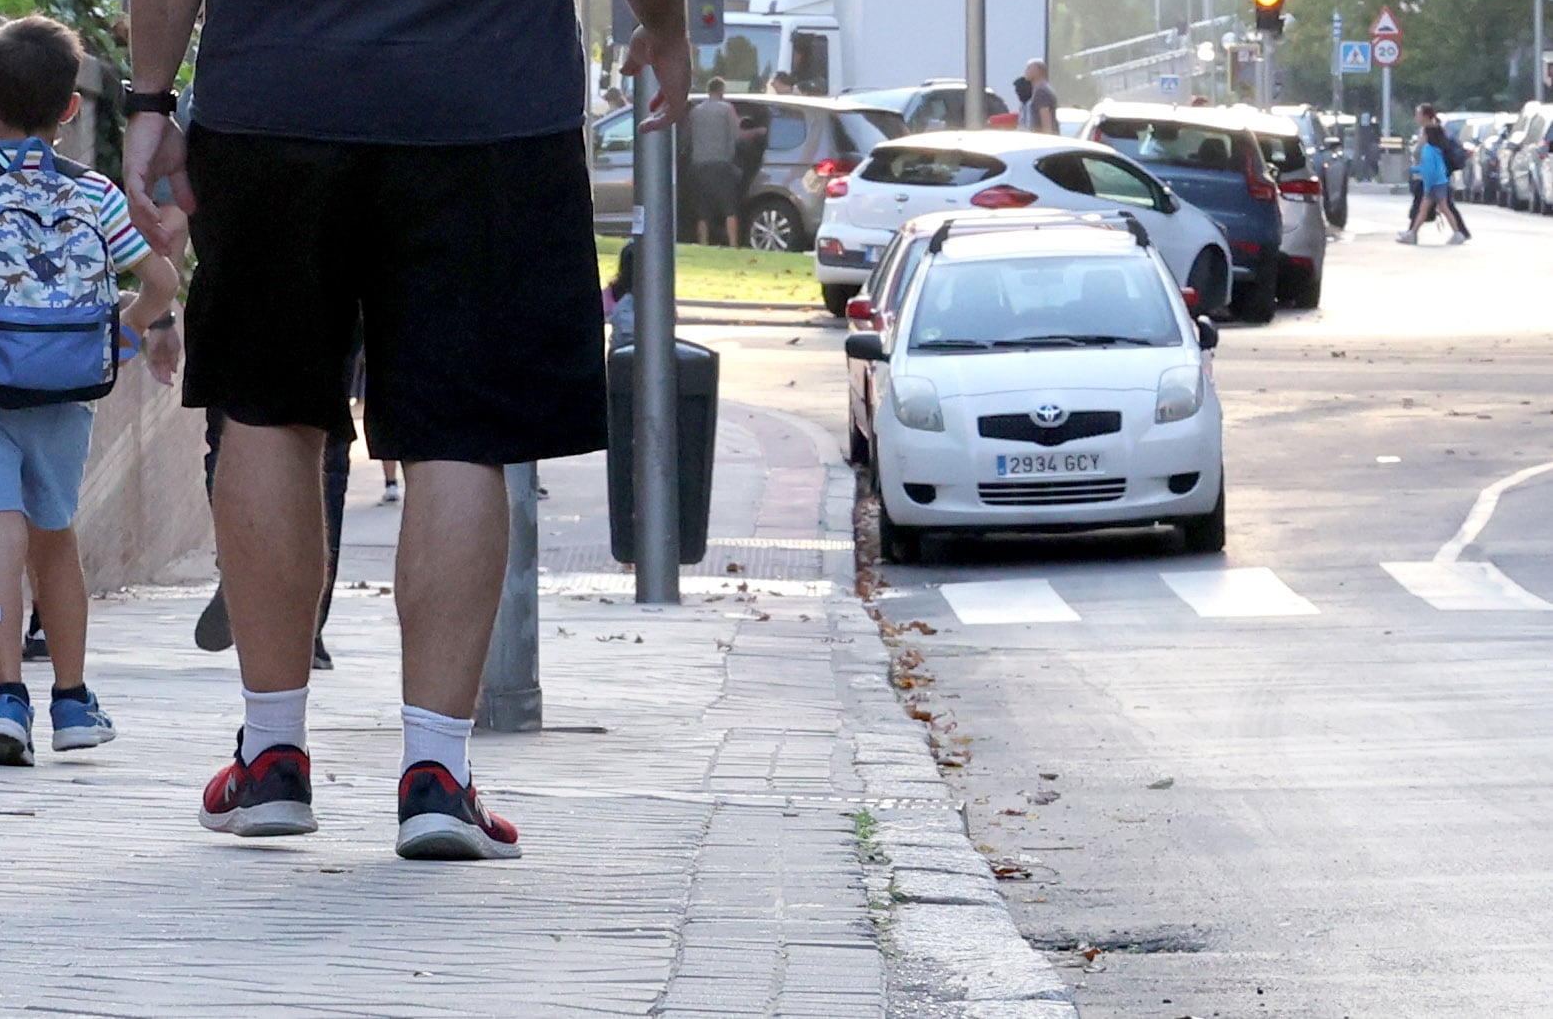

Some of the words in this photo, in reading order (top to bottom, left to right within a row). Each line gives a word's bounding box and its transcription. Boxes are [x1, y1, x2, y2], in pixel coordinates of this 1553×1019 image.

[1378, 46, 1397, 57] 20
[1010, 455, 1057, 474] 2934
[1065, 454, 1100, 472] GCY
